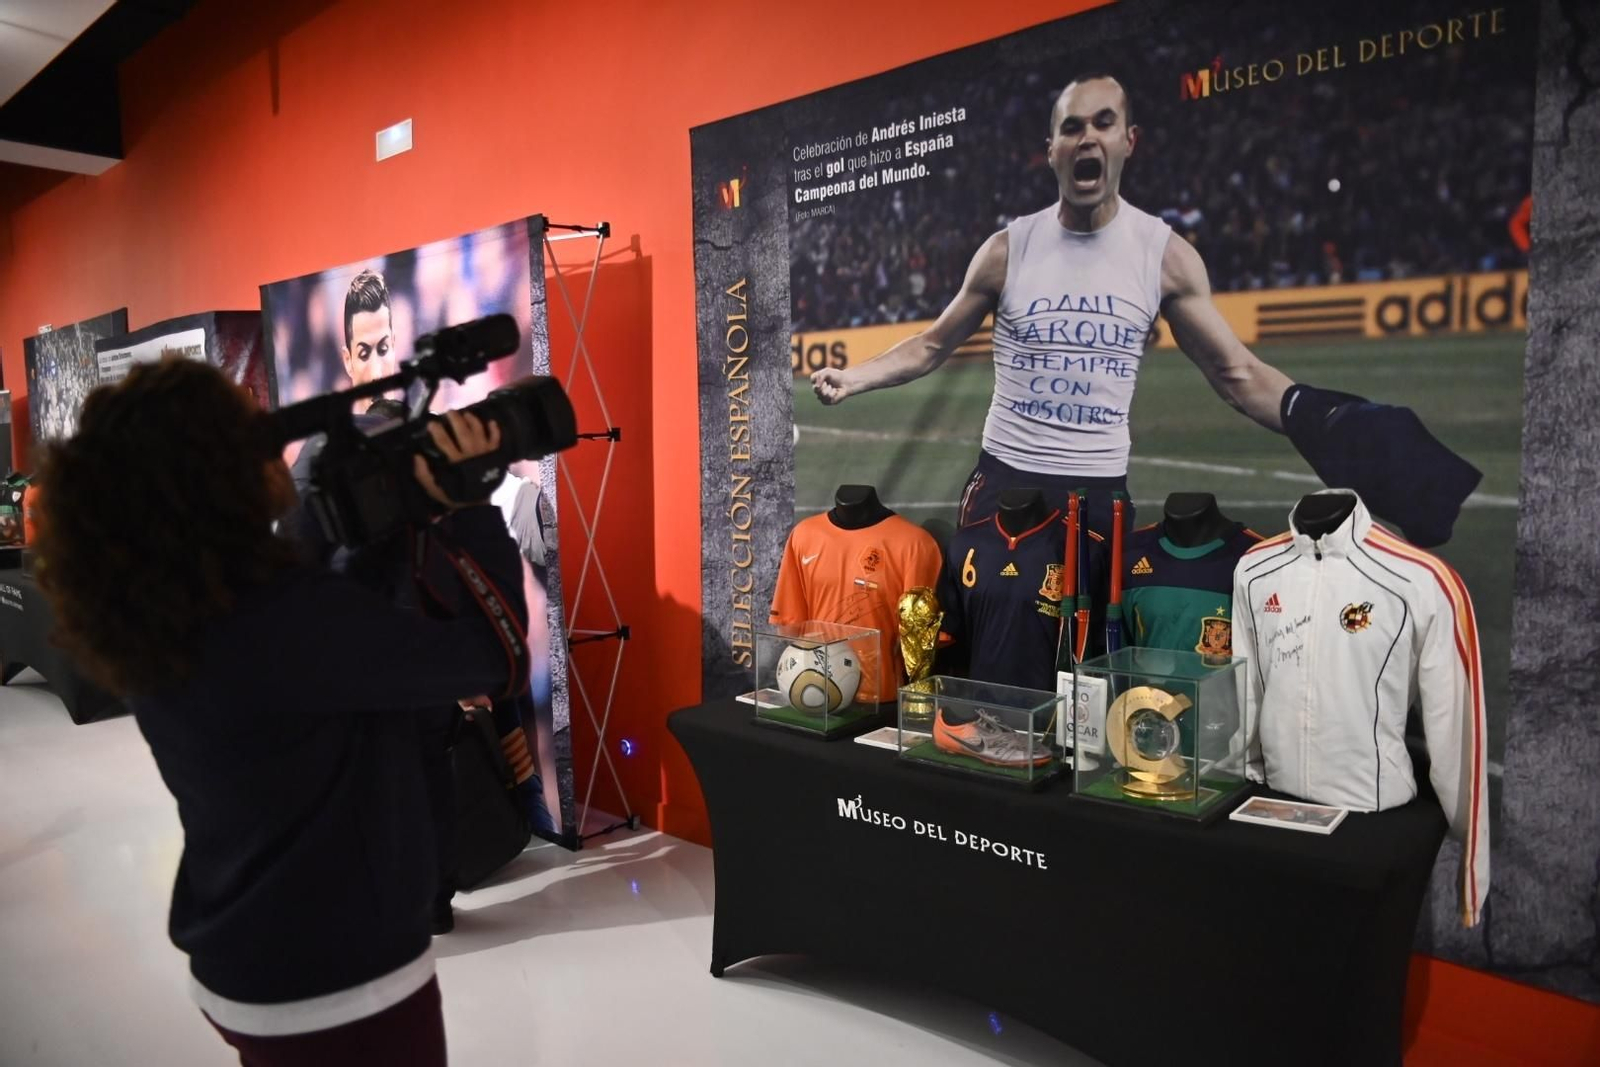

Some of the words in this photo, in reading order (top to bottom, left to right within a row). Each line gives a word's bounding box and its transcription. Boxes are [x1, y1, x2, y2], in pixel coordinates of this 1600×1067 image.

[1180, 57, 1284, 99] MUSEO
[1297, 45, 1346, 76] DEL
[1359, 7, 1506, 63] DEPORTE
[793, 135, 852, 162] Celebración
[855, 131, 869, 148] de
[871, 119, 916, 143] Andrés
[919, 106, 967, 131] Iniesta
[794, 168, 812, 183] tras
[814, 163, 824, 178] el
[826, 157, 845, 178] gol
[847, 156, 867, 173] que
[870, 149, 892, 166] hizo
[894, 147, 902, 160] a
[904, 133, 954, 158] España
[795, 179, 856, 204] Campeona
[859, 172, 878, 191] del
[882, 162, 931, 186] Mundo.
[811, 205, 836, 217] MARCA)
[1026, 294, 1114, 316] DANI
[1376, 271, 1529, 333] adid
[722, 277, 751, 462] ESPAÑOLA
[1011, 353, 1132, 378] SIEMPRE
[1030, 375, 1091, 396] CON
[726, 474, 754, 669] SELECCIÓN
[962, 548, 977, 588] 6
[837, 795, 907, 830] MUSEO
[913, 820, 947, 841] DEL
[954, 830, 1048, 870] DEPORTE
